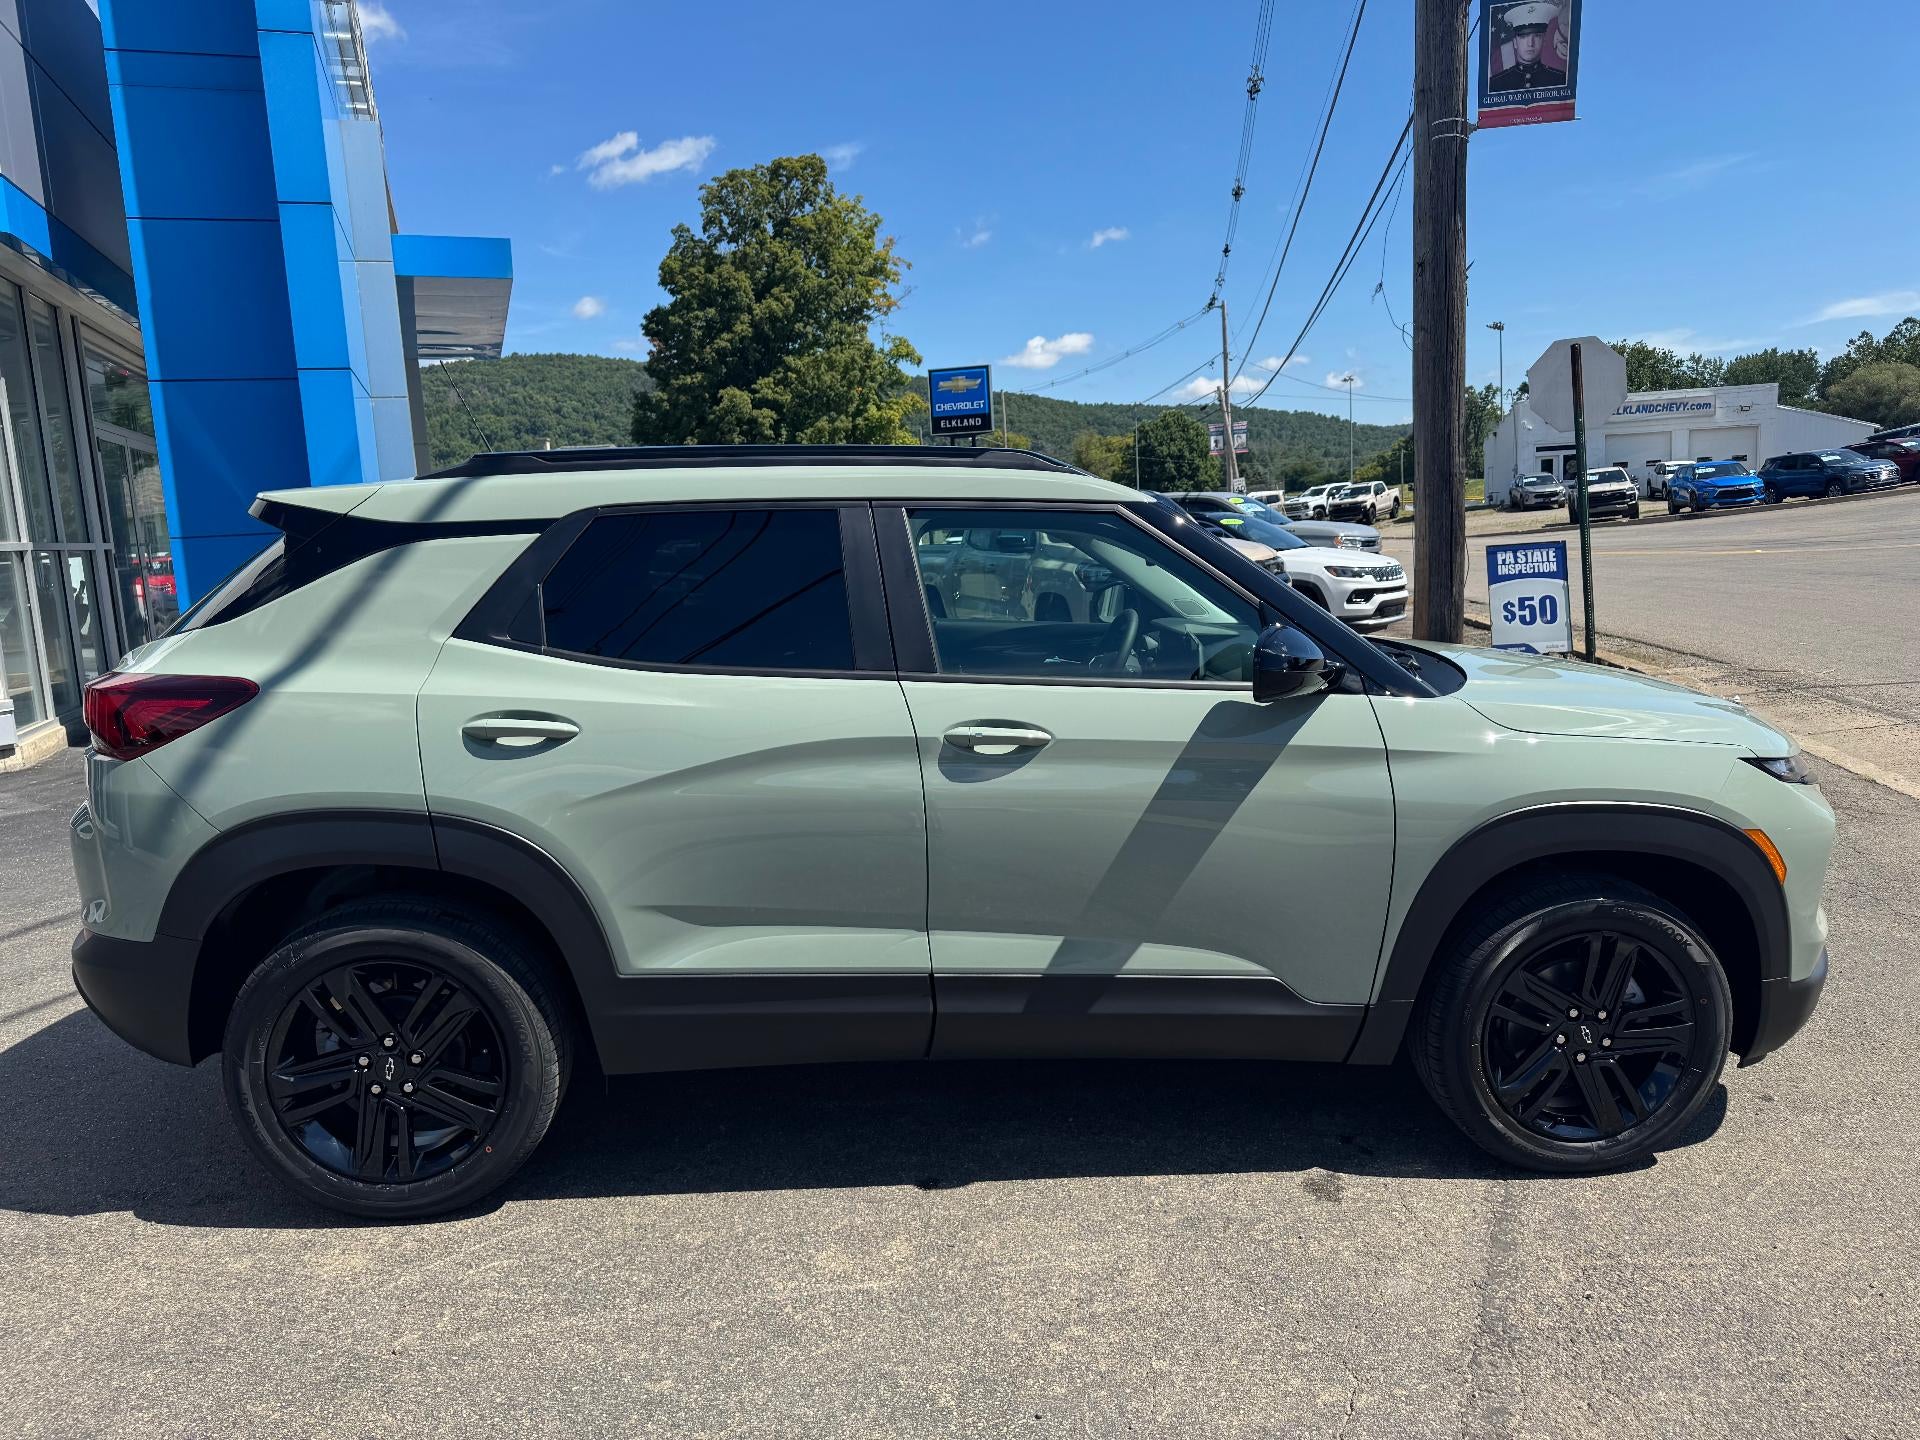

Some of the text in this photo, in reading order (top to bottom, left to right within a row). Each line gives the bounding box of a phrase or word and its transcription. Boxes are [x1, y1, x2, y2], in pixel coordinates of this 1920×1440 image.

[1483, 95, 1508, 104] GLOBAL
[1508, 93, 1522, 101] WAR
[1522, 92, 1532, 100] ON
[1560, 89, 1571, 97] KIA
[935, 400, 984, 411] CHEVROLET
[1612, 402, 1711, 415] LKLANDCHEVY.com
[940, 417, 982, 428] ELKLAND
[1497, 548, 1556, 565] PA STATE
[1497, 562, 1557, 575] INSPECTION
[1502, 594, 1558, 626] $50
